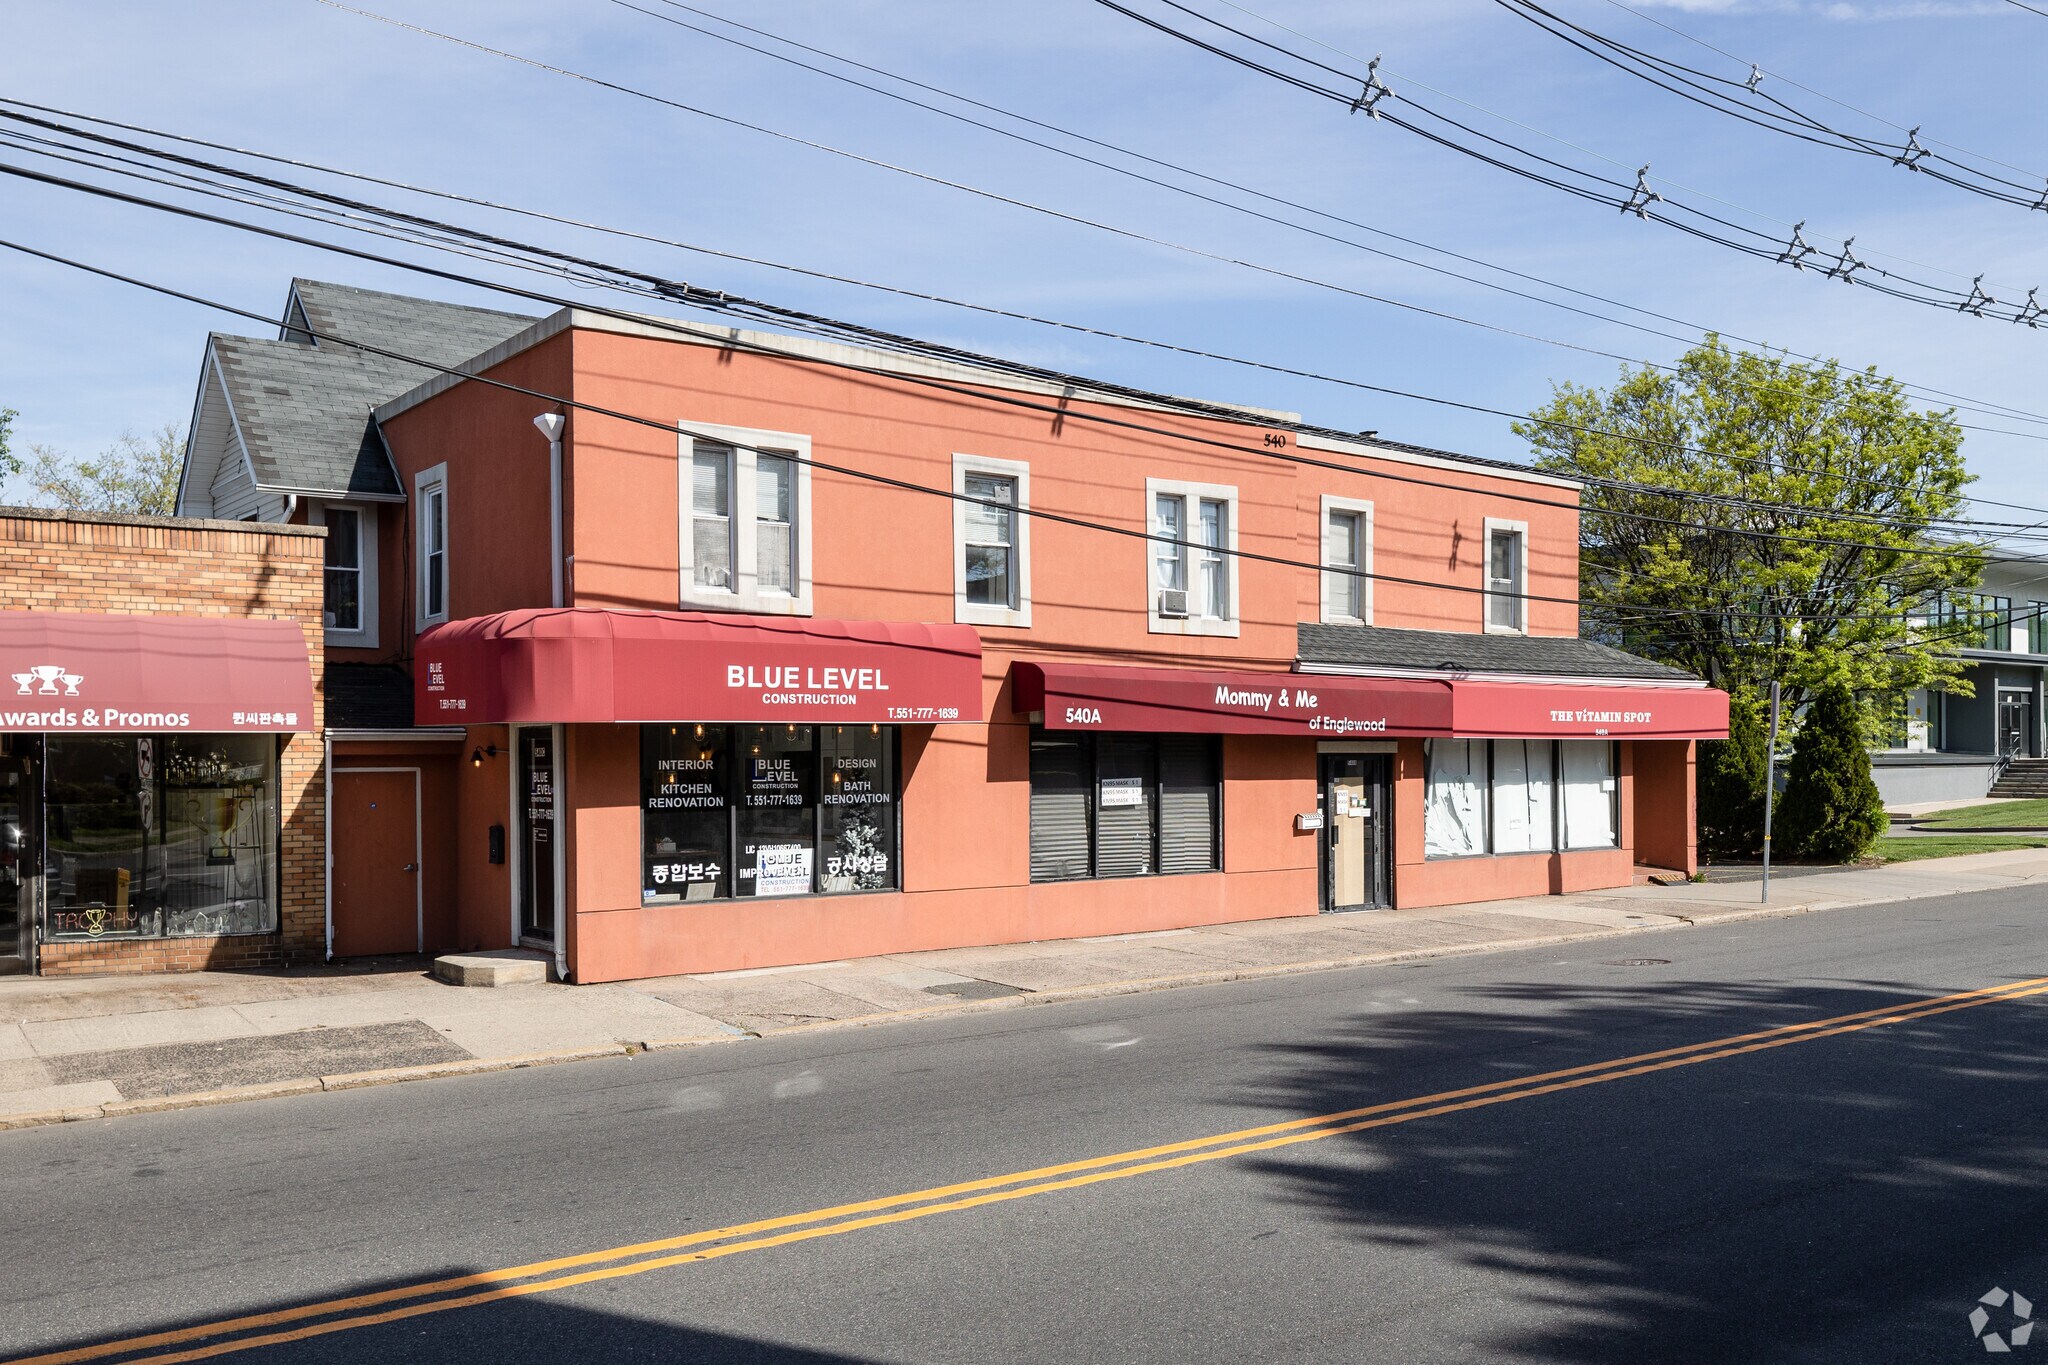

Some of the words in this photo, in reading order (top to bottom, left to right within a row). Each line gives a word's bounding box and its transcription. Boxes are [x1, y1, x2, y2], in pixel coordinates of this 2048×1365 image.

[1264, 434, 1286, 448] 540
[727, 665, 800, 689] BLUE
[807, 667, 889, 690] LEVEL
[762, 693, 856, 705] CONSTRUCTION
[1215, 686, 1272, 712] Mommy
[1278, 689, 1290, 707] &
[1295, 690, 1318, 708] Me
[82, 708, 100, 727] &
[104, 708, 190, 727] Promos
[888, 707, 958, 719] T.551-777-1639
[1065, 708, 1102, 724] 540A
[1550, 710, 1573, 721] THE
[1623, 712, 1652, 723] SPOT
[1309, 717, 1321, 729] of
[1324, 717, 1386, 733] Englewood
[658, 760, 714, 770] INTERIOR
[758, 759, 791, 770] BLUE
[838, 759, 877, 769] DESIGN
[661, 784, 712, 794] KITCHEN
[843, 781, 871, 791] BATH
[649, 797, 724, 808] RENOVATION
[754, 794, 803, 806] 551-777-1639
[824, 793, 890, 804] RENOVATION
[827, 855, 888, 875] 공사상담
[652, 862, 721, 884] 종합보수
[761, 878, 810, 886] CONSTRUCTION
